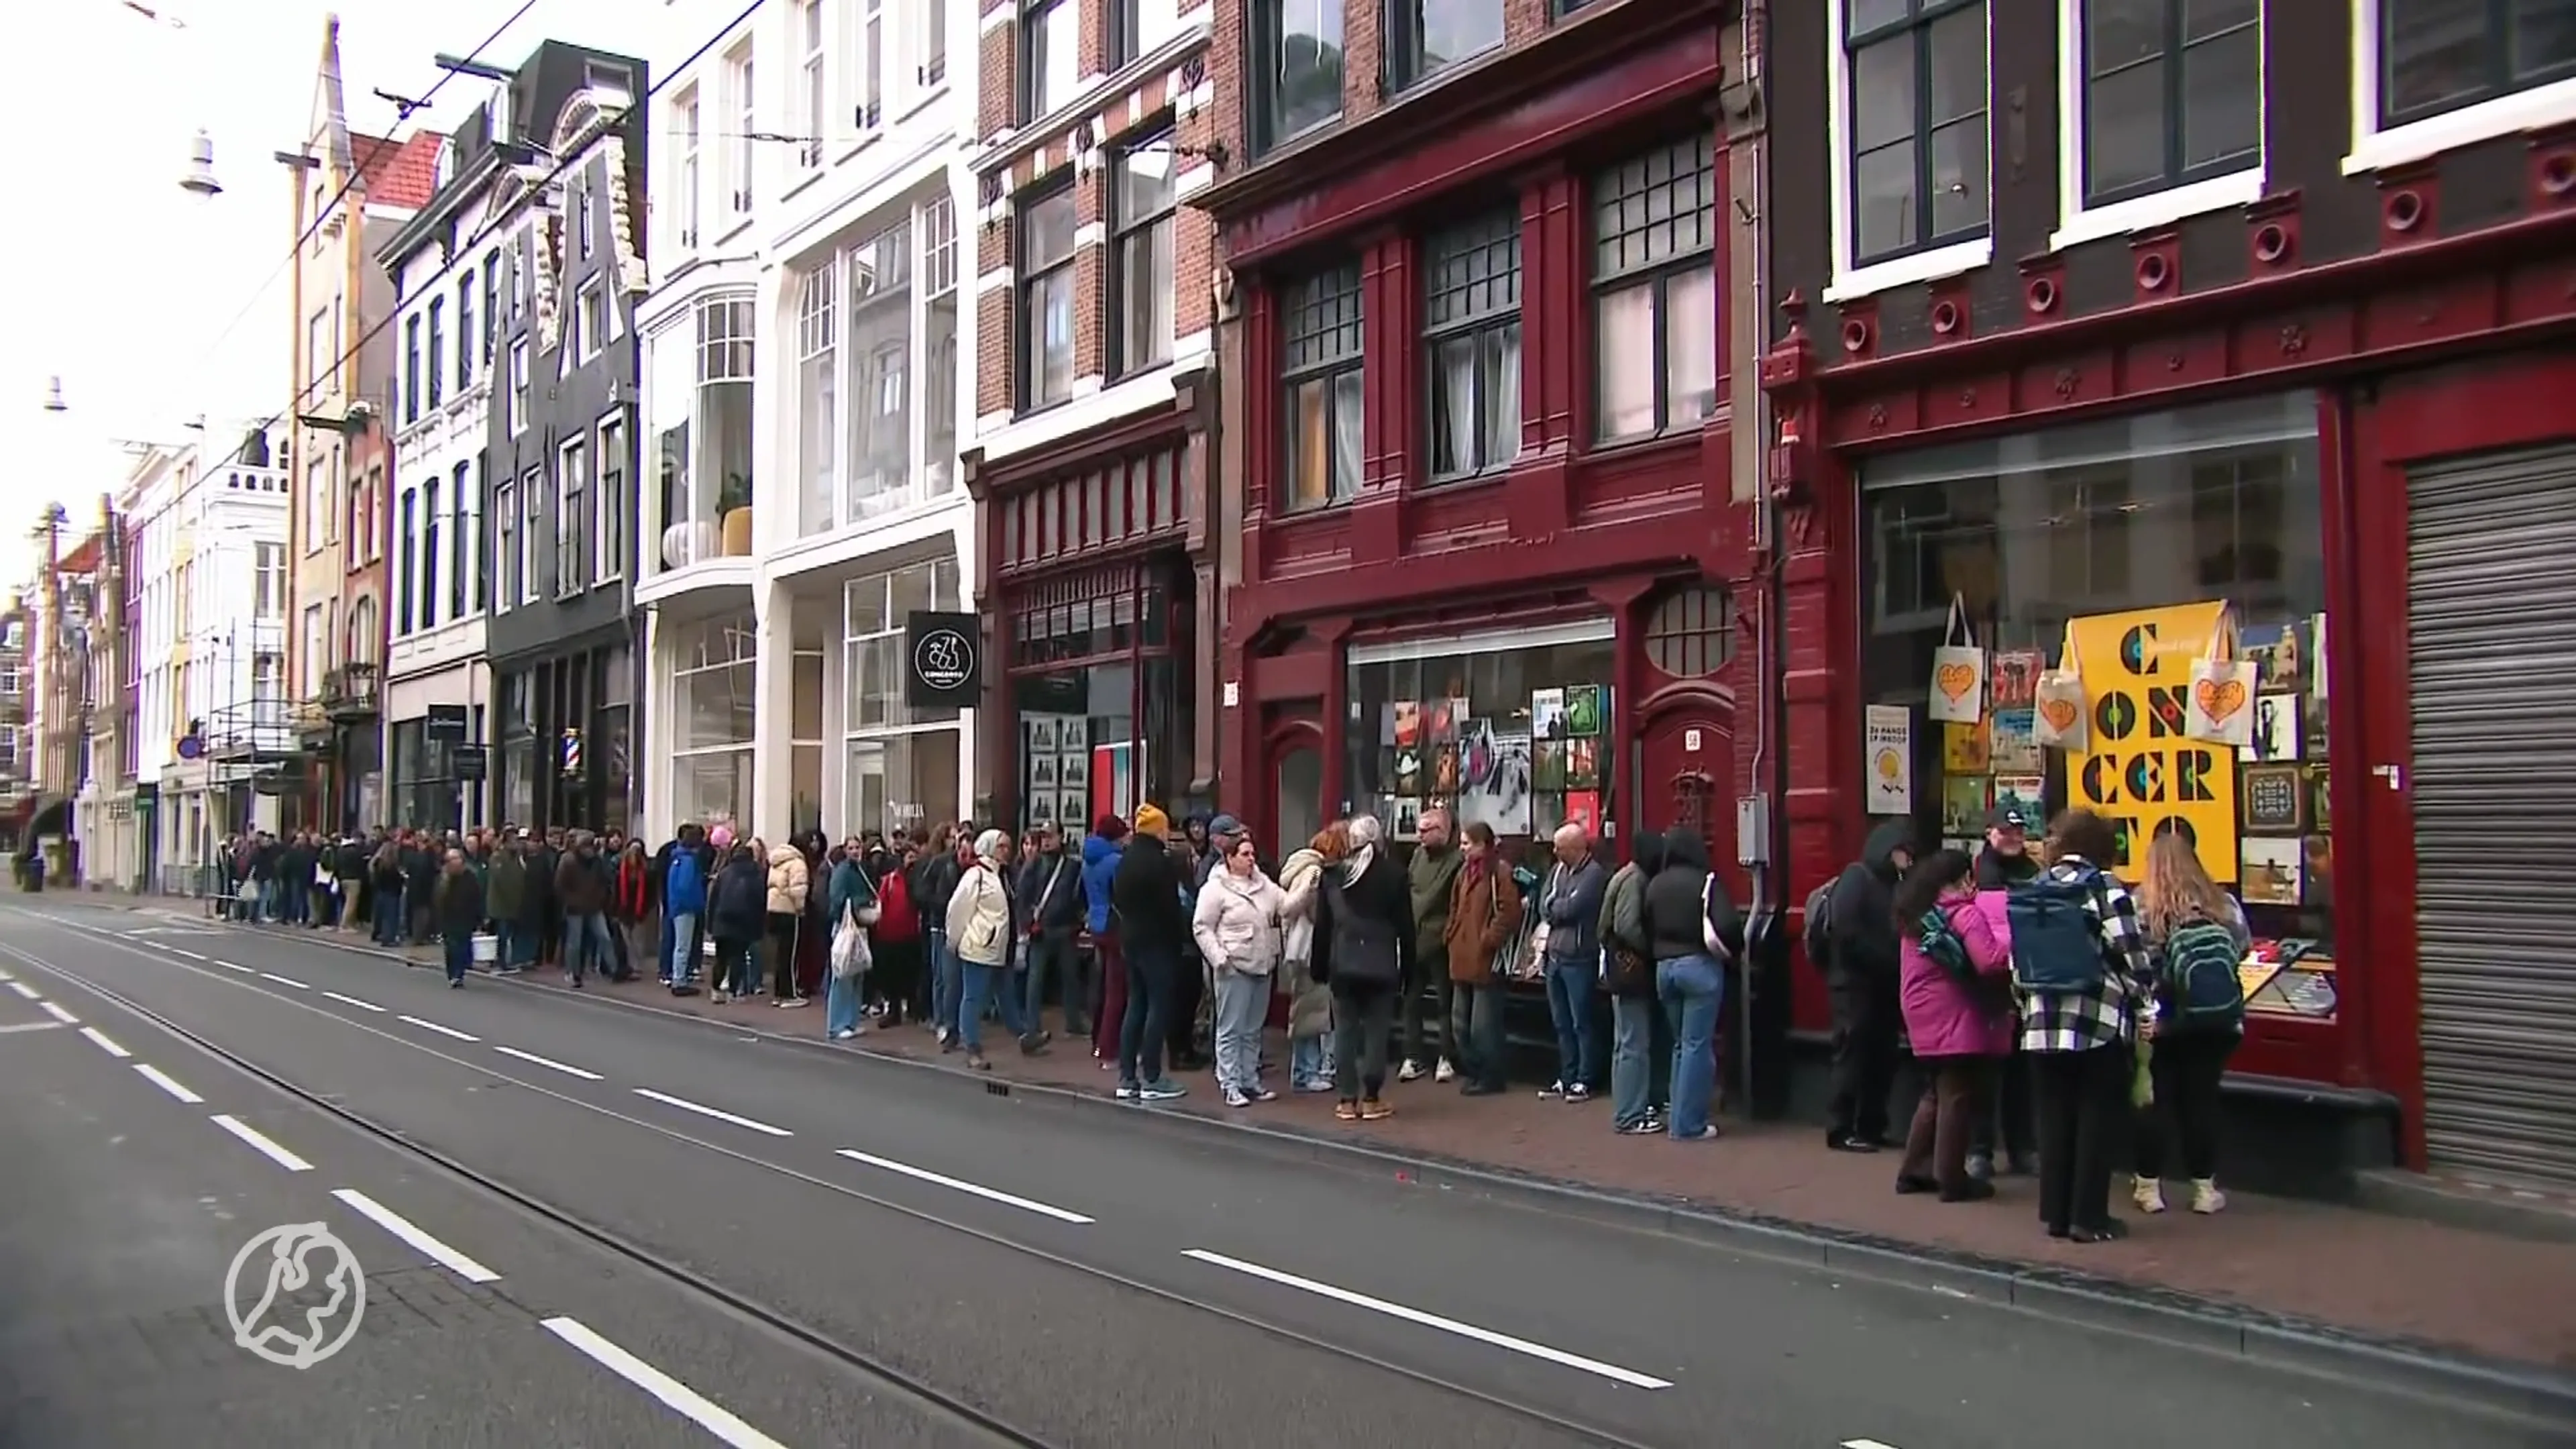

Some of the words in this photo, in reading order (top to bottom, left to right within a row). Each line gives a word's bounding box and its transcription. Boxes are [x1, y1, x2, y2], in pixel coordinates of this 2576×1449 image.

[2121, 623, 2157, 675] C
[2096, 685, 2188, 741] ON
[2082, 750, 2215, 804] CER
